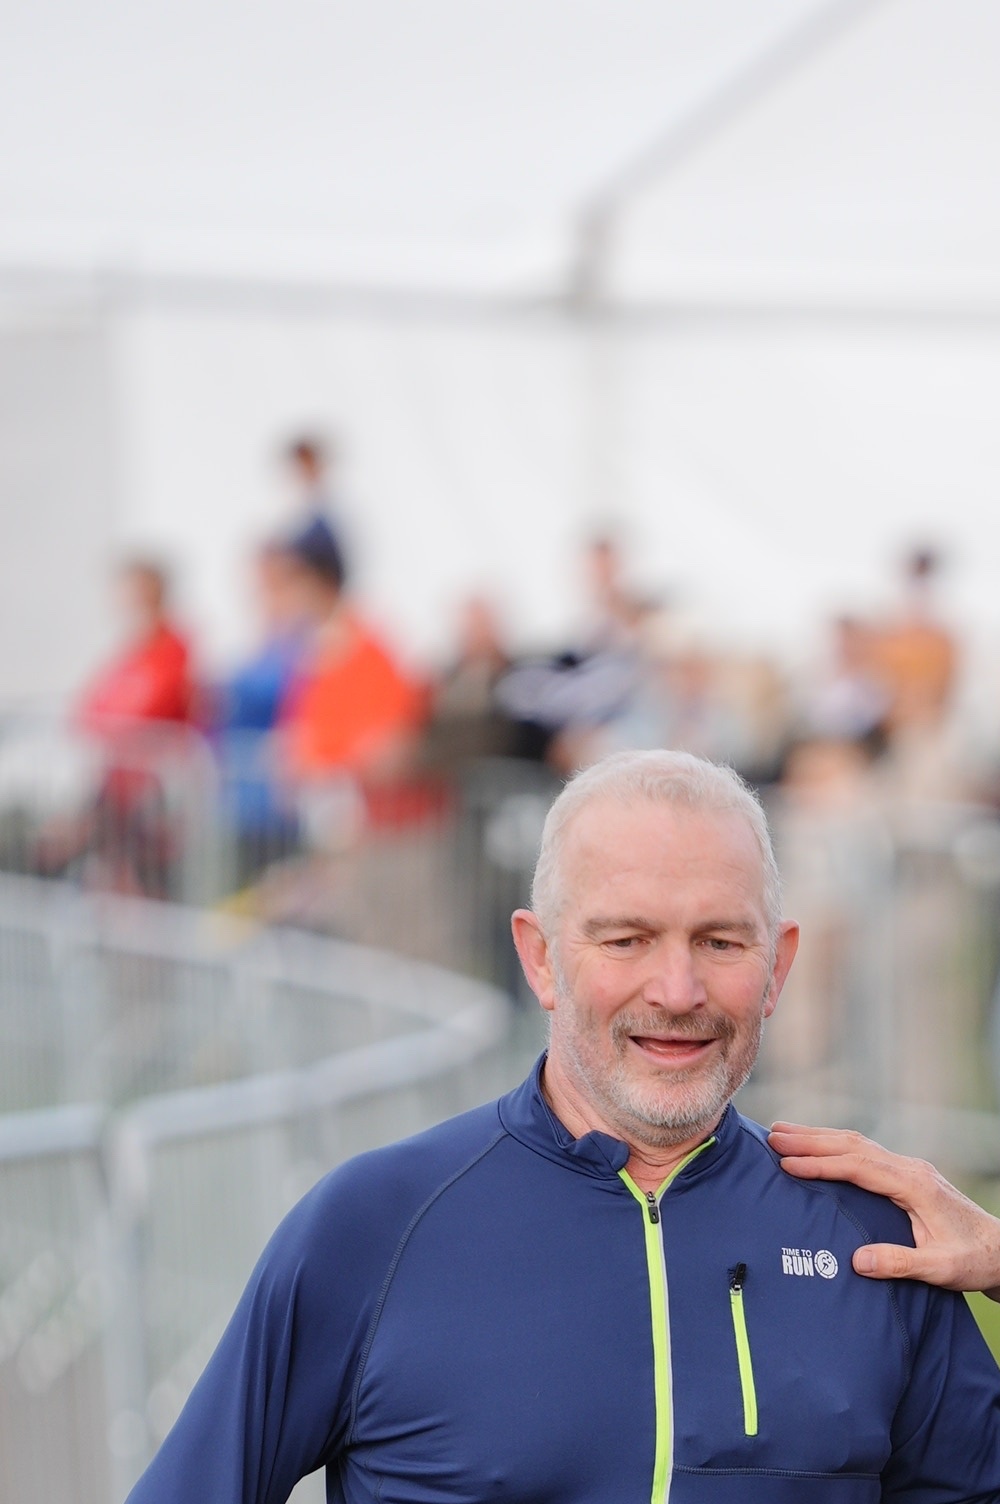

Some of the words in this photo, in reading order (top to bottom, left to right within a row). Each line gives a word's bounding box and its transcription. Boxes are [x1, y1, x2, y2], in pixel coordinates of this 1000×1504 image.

[781, 1247, 800, 1257] TIME
[801, 1249, 812, 1258] TO
[781, 1254, 814, 1277] RUN
